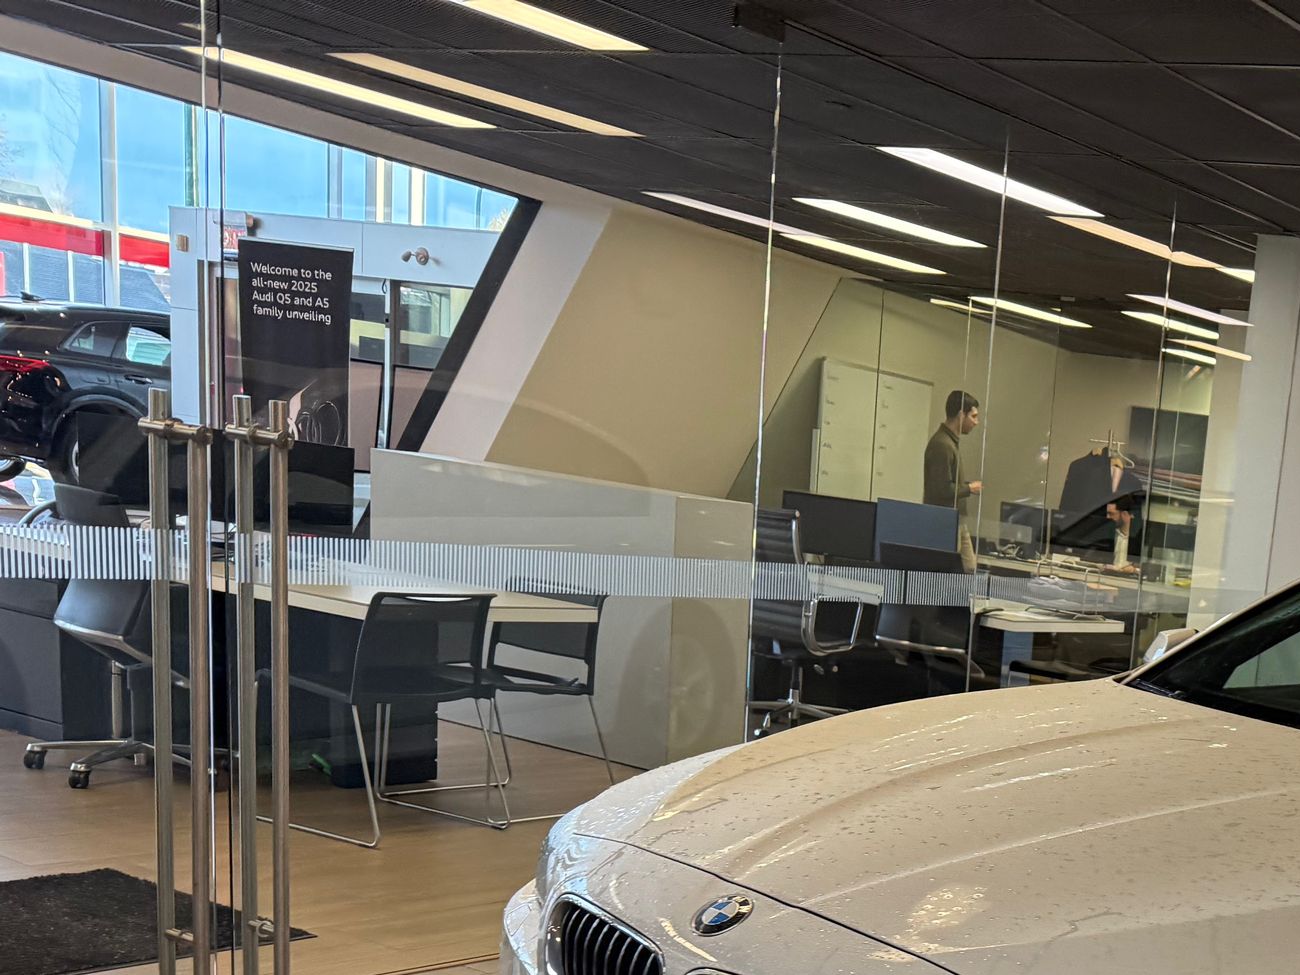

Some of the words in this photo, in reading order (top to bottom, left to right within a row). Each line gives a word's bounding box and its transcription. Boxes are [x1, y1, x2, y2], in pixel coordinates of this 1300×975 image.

[250, 262, 298, 277] Welcome
[301, 269, 312, 278] to
[314, 268, 332, 280] the
[252, 277, 288, 289] all-new
[291, 280, 318, 293] 2025
[252, 290, 274, 302] Audi
[276, 292, 291, 305] Q5
[294, 296, 312, 307] and
[315, 297, 329, 308] A5
[253, 304, 283, 319] family
[286, 310, 331, 325] unveiling
